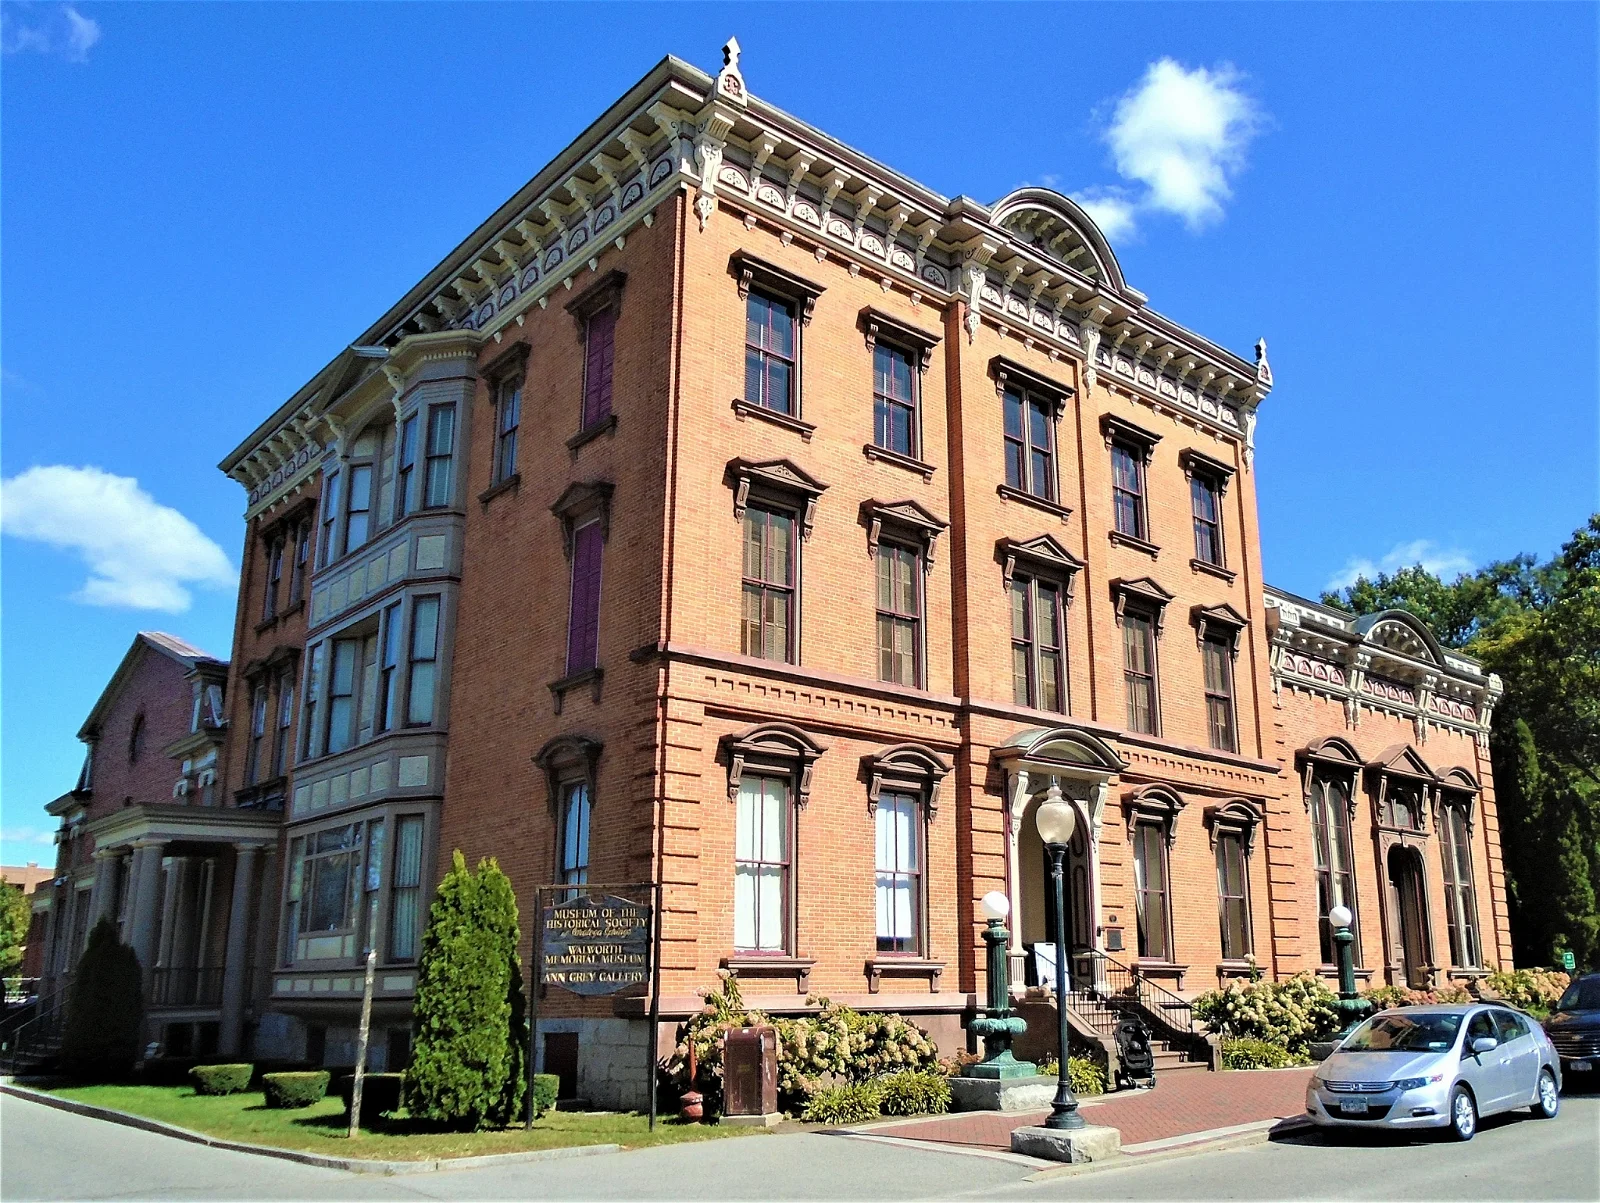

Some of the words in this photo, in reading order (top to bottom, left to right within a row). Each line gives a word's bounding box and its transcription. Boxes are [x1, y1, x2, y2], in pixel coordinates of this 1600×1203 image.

[554, 908, 597, 919] MUSEUM
[601, 908, 614, 918] OF
[621, 908, 637, 918] THE
[546, 919, 600, 929] HISTORICAL
[605, 918, 648, 928] SOCIETY
[568, 944, 623, 955] WALWORTH
[545, 955, 596, 965] MEMORIAL
[602, 955, 645, 964] MUSEUM
[544, 972, 566, 982] ANN
[569, 972, 596, 982] GREY
[599, 972, 644, 982] GALLERY
